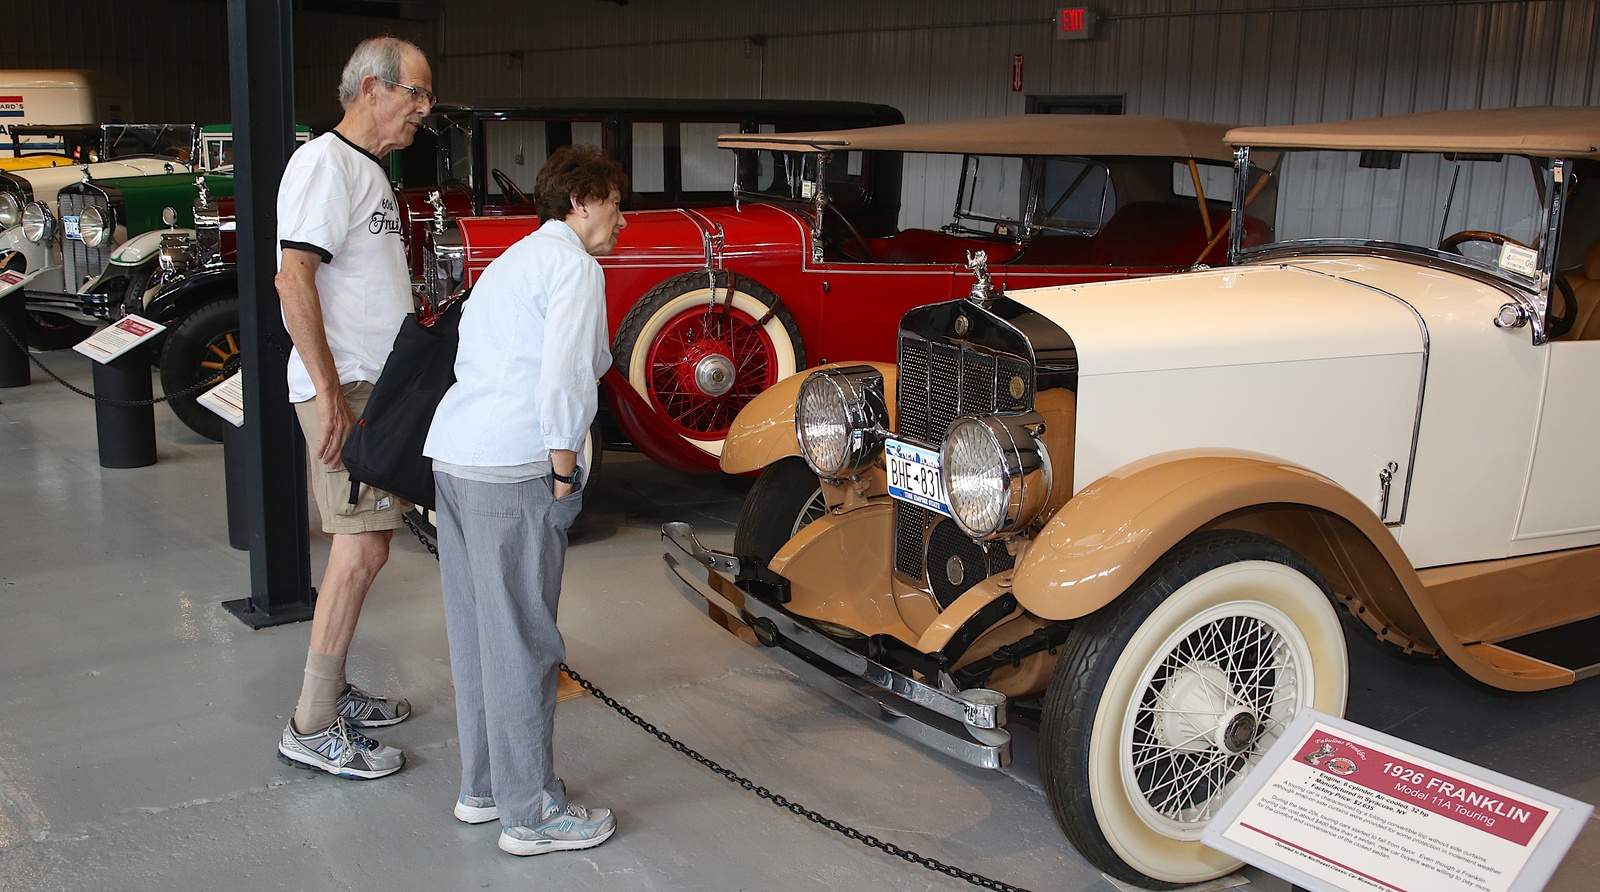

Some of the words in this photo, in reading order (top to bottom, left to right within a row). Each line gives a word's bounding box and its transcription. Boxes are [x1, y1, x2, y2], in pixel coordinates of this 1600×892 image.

[1062, 9, 1084, 31] EXIT
[1311, 783, 1334, 796] Factory
[1334, 792, 1351, 802] Price:
[1353, 800, 1374, 811] $2,635
[1315, 778, 1357, 797] Manufactured
[1364, 797, 1394, 812] Syracuse,
[1319, 773, 1341, 784] Engine:
[1348, 785, 1374, 797] cylinder,
[1375, 794, 1409, 811] Air-cooled,
[1383, 762, 1425, 784] 1926
[1426, 777, 1531, 823] FRANKLIN
[1394, 782, 1429, 800] Model
[1432, 796, 1451, 810] 11A
[1455, 803, 1496, 827] Touring
[1271, 794, 1289, 805] During
[1320, 814, 1339, 825] touring
[1351, 827, 1371, 837] started
[1386, 840, 1400, 849] from
[1418, 853, 1434, 863] Even
[1434, 860, 1455, 871] though
[1461, 870, 1486, 883] Franklin
[1272, 783, 1295, 794] although
[1295, 792, 1316, 802] snap-on
[1327, 805, 1349, 815] curtains
[1362, 818, 1388, 830] provided
[1396, 831, 1412, 840] some
[1411, 838, 1441, 851] protection
[1448, 851, 1477, 865] inclement
[1273, 809, 1294, 820] comfort
[1304, 822, 1337, 837] convenience
[1353, 842, 1372, 852] closed
[1288, 782, 1306, 793] touring
[1320, 795, 1356, 811] characterized
[1368, 813, 1387, 824] folding
[1387, 821, 1417, 835] convertible
[1428, 837, 1450, 848] without
[1449, 845, 1462, 853] side
[1261, 797, 1279, 808] touring
[1299, 813, 1315, 822] about
[1314, 818, 1329, 827] $400
[1329, 824, 1340, 832] less
[1340, 829, 1353, 837] than
[1400, 853, 1420, 864] buyers
[1421, 862, 1435, 870] were
[1436, 868, 1455, 879] willing
[1461, 878, 1474, 886] pay
[1474, 884, 1491, 892] more
[1274, 842, 1295, 852] Donated
[1308, 856, 1331, 868] Northeast
[1330, 865, 1347, 875] Classic
[1357, 877, 1378, 888] Museum
